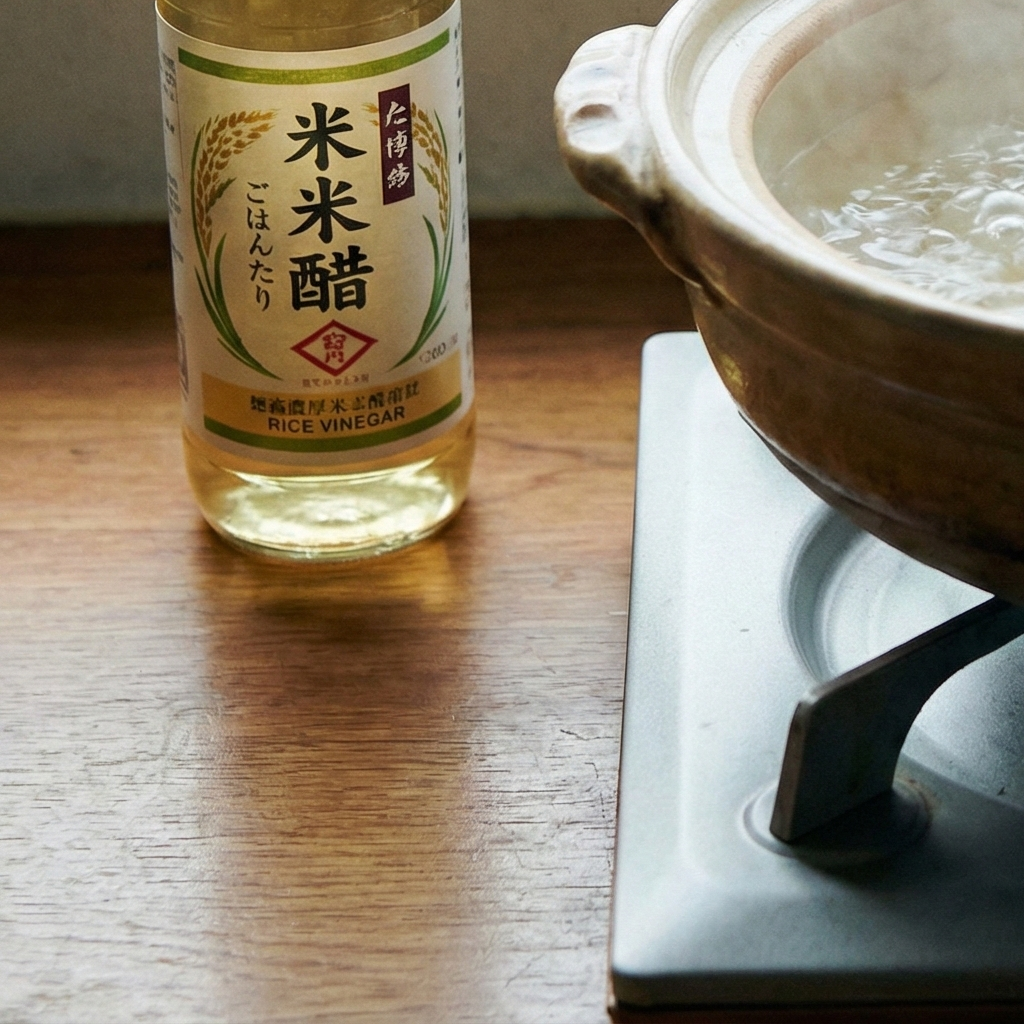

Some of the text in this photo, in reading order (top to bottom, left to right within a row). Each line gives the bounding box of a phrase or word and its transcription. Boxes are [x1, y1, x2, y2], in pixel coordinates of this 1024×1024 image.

[246, 181, 274, 312] ごはんたり
[284, 101, 375, 314] 米米醋
[268, 406, 405, 434] RICE VINEGAR
